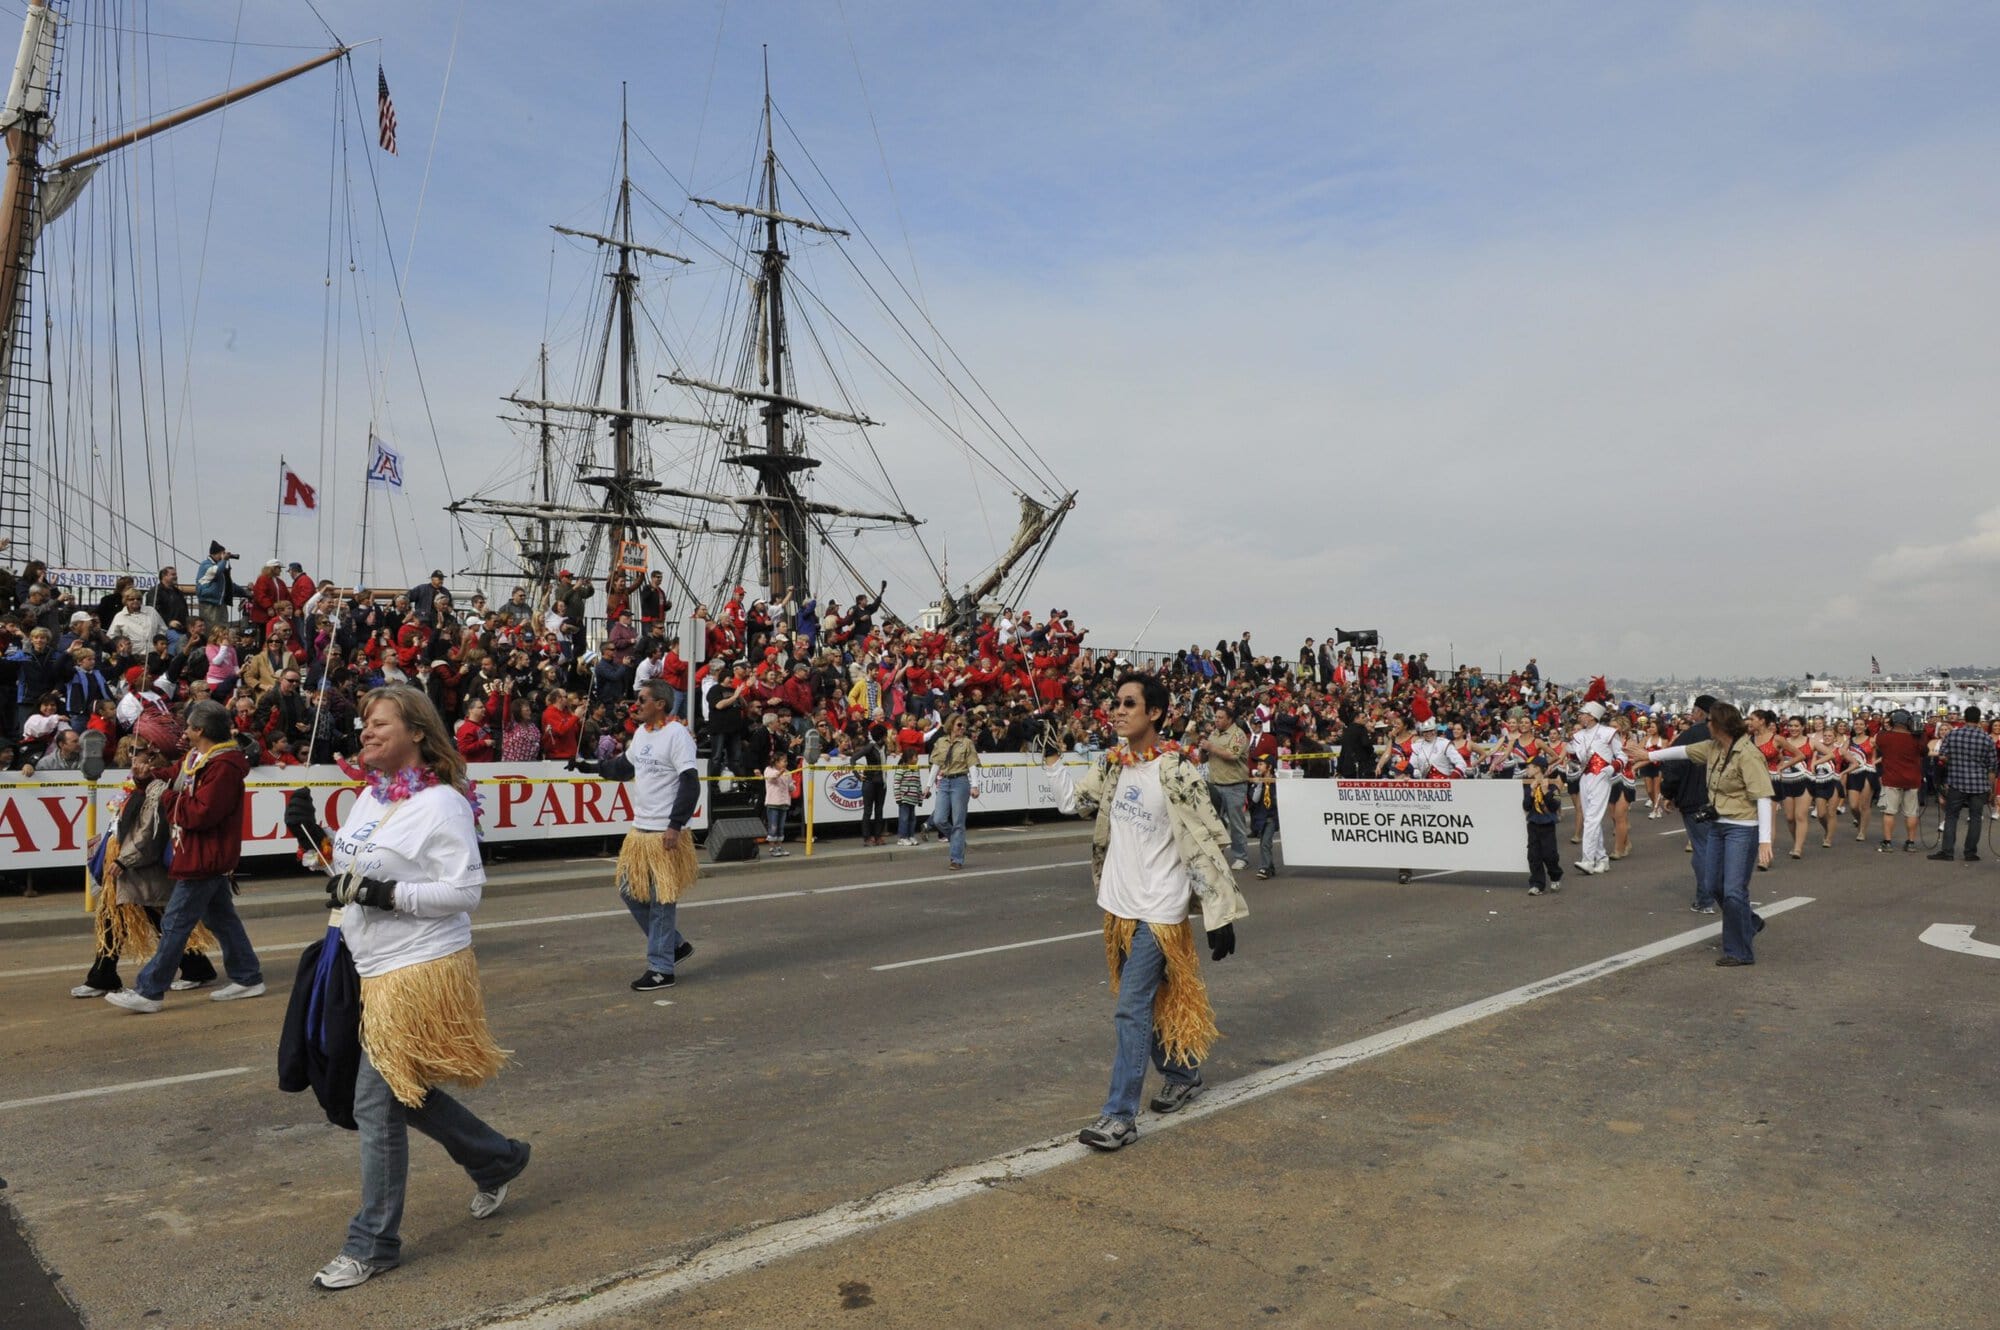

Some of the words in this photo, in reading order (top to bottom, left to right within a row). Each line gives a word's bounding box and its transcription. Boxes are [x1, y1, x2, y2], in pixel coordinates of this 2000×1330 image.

[368, 446, 402, 487] A
[284, 472, 316, 510] N
[70, 572, 91, 586] ARE
[95, 573, 121, 586] FRE
[132, 576, 159, 589] ODAY
[981, 767, 1013, 779] County
[985, 779, 1012, 794] Union
[492, 775, 702, 829] PARA
[829, 792, 857, 809] HOLIDAY
[1338, 789, 1354, 801] BIG
[1355, 789, 1372, 801] BAY
[1373, 789, 1415, 801] BALLOON
[1417, 789, 1453, 802] PARADE
[1323, 812, 1370, 826] PRIDE
[1374, 813, 1396, 827] OF
[1400, 813, 1474, 828] ARIZONA
[1331, 829, 1418, 843] MARCHING
[1423, 831, 1469, 845] BAND
